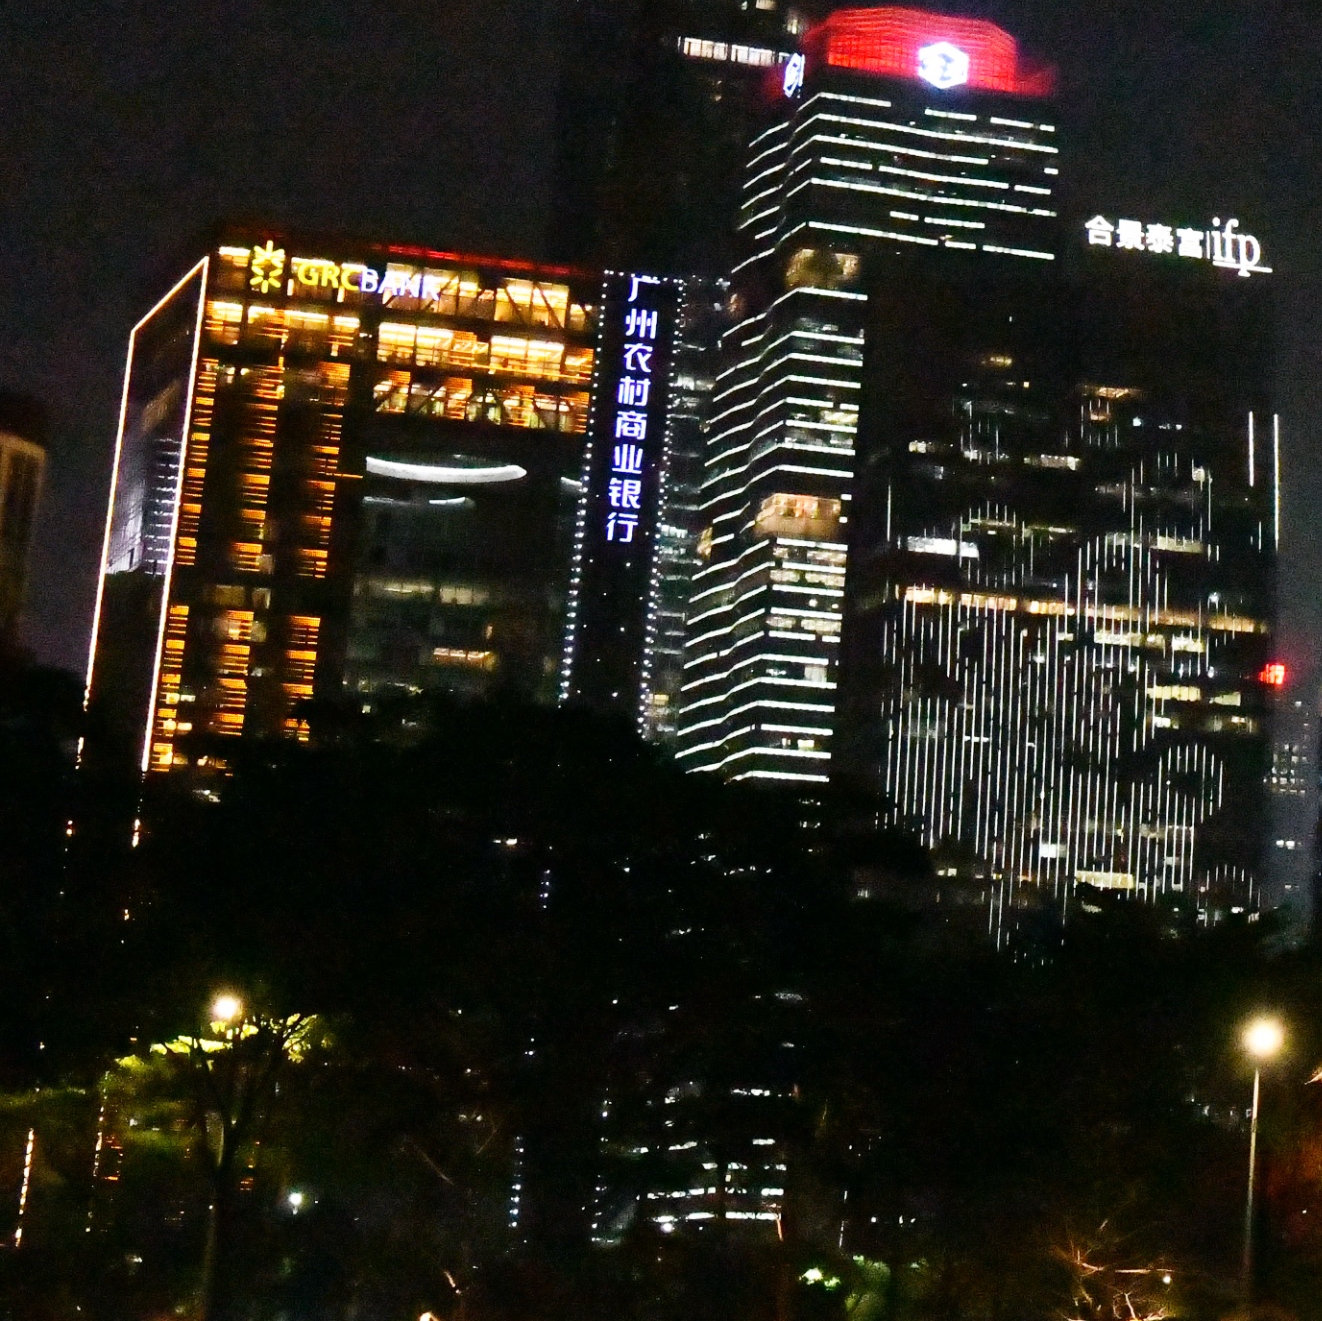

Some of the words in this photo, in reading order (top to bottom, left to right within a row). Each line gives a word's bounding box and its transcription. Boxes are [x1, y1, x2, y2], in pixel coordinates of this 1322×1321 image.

[1085, 215, 1204, 259] 合景泰富
[1212, 216, 1264, 278] ifp
[606, 275, 661, 543] 广州农村商业银行
